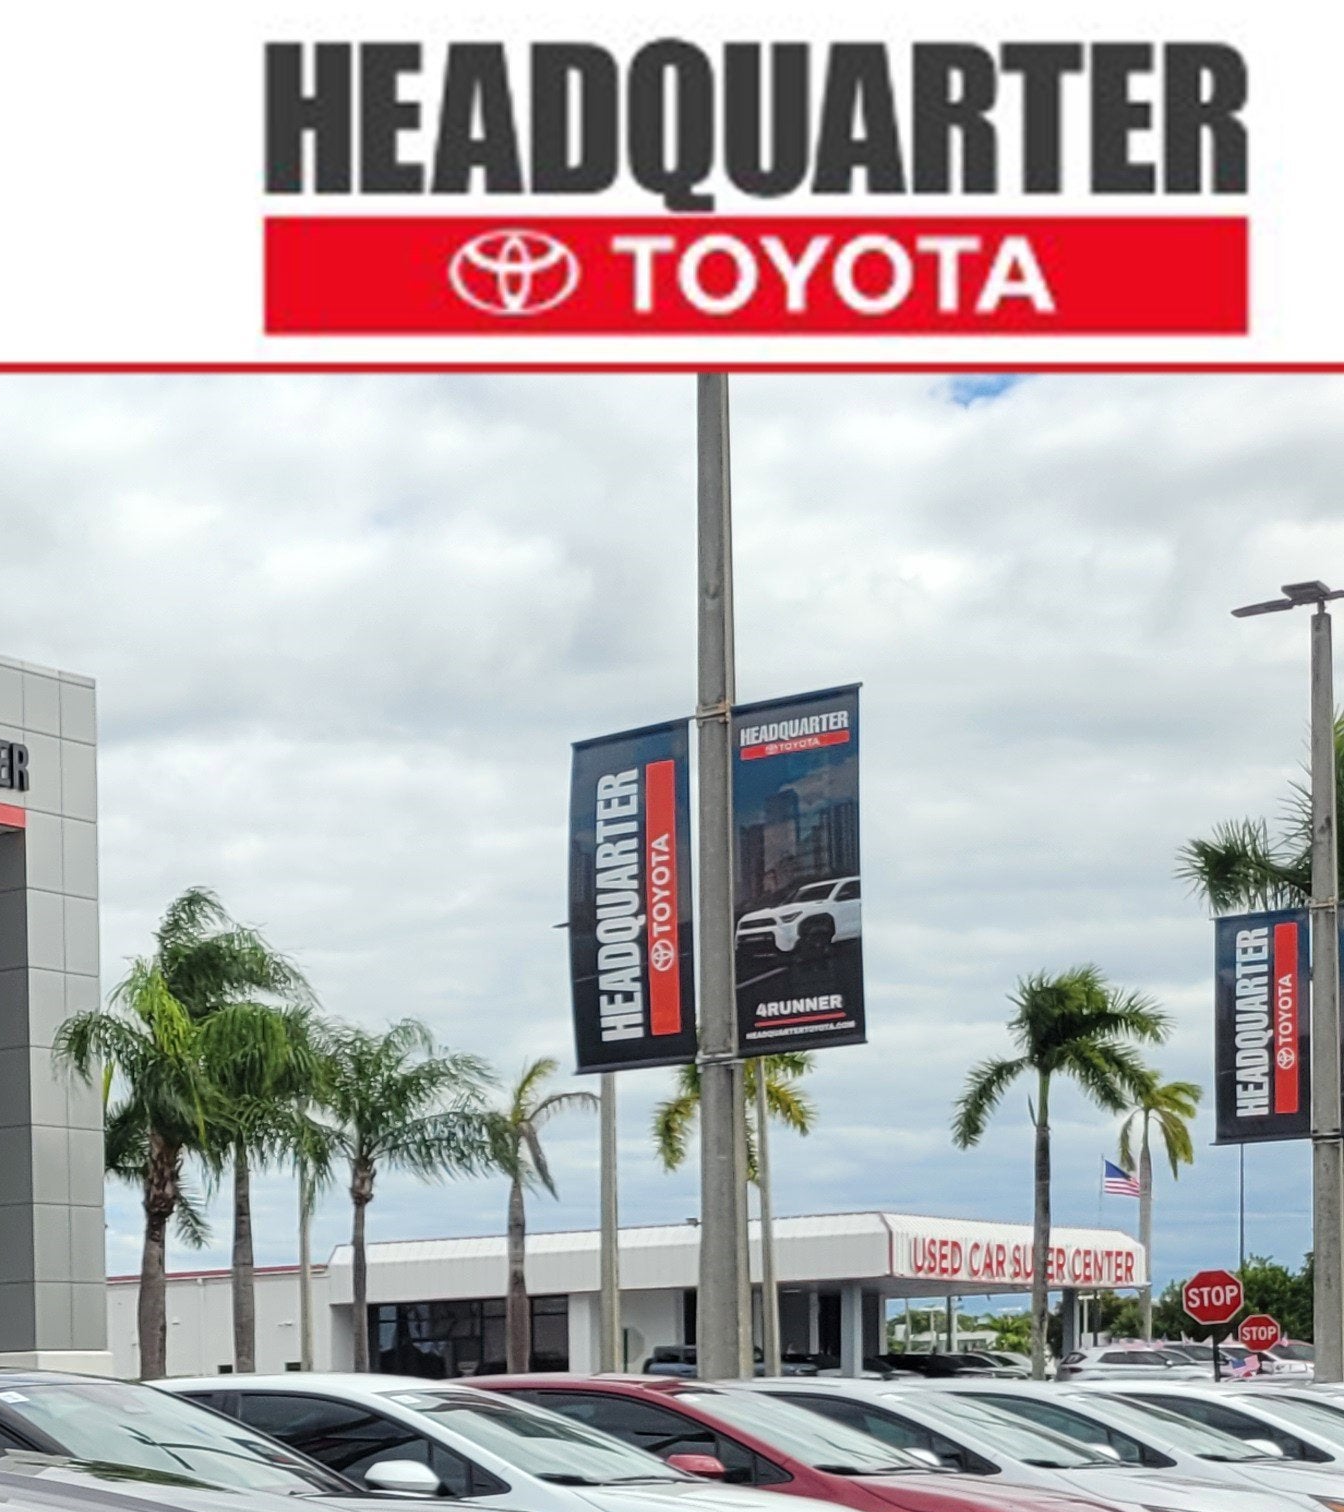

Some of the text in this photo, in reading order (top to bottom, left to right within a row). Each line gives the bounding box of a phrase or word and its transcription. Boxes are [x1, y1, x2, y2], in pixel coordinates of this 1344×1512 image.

[740, 711, 849, 747] HEADQUARTER
[779, 737, 820, 752] TOYOTA
[595, 767, 646, 1042] HEADQUARTER
[651, 833, 672, 937] TOYOTA
[755, 994, 843, 1018] 4RUNNER
[1236, 926, 1273, 1118] HEADQUARTER
[1278, 973, 1293, 1046] TOYOTA
[914, 1237, 1135, 1283] USED CAR SUER CENTER
[1187, 1285, 1238, 1308] STOP
[1242, 1326, 1277, 1341] STOP
